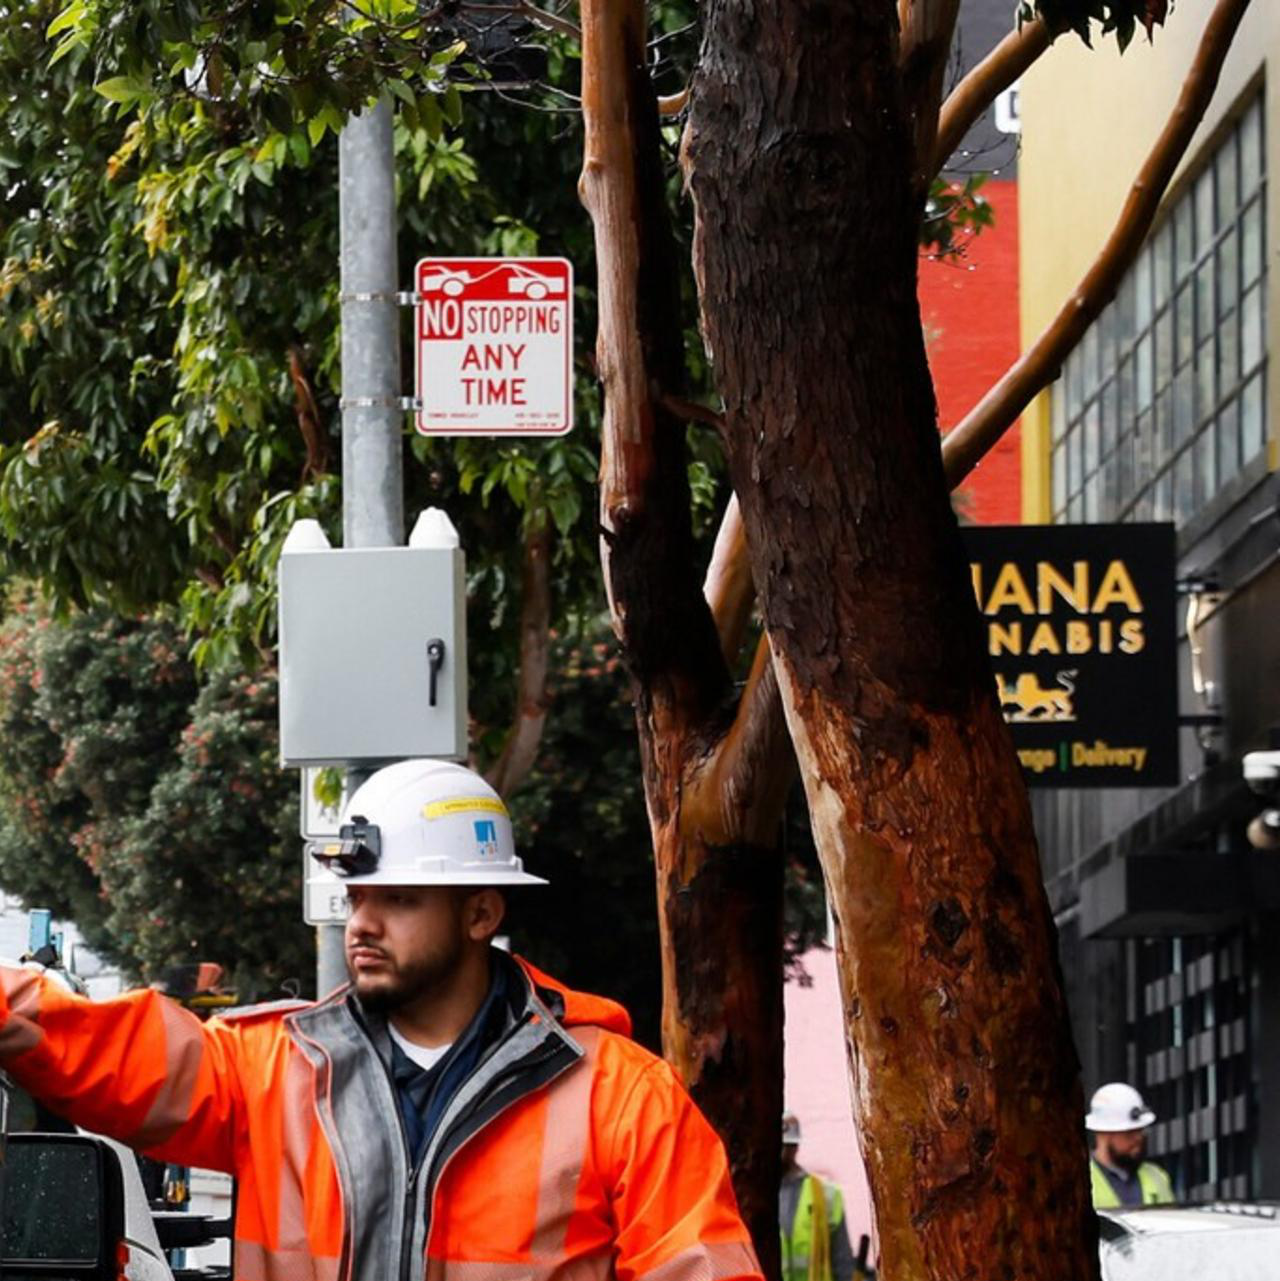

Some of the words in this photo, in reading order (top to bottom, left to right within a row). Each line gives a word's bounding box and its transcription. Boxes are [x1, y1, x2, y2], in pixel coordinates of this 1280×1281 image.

[423, 300, 461, 336] NO
[467, 306, 560, 334] STOPPING
[461, 344, 527, 371] ANY
[461, 378, 527, 406] TIME
[1072, 739, 1146, 772] Delivery
